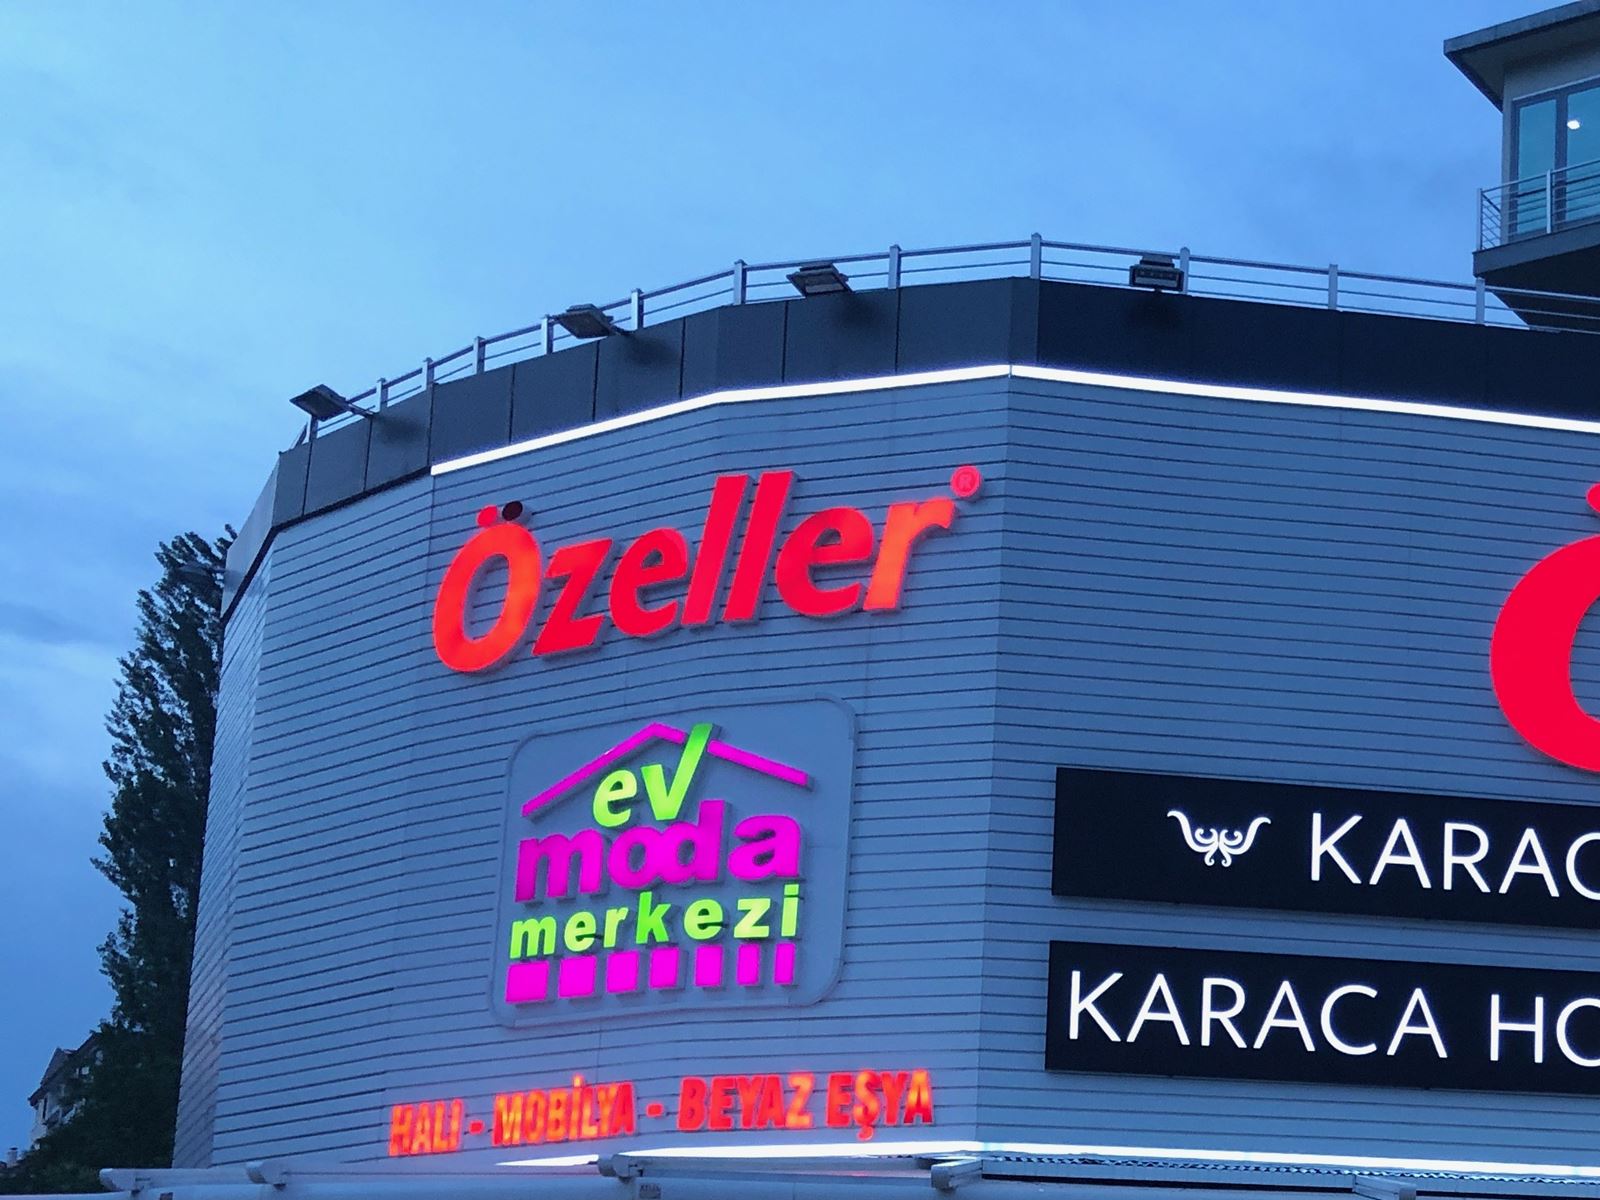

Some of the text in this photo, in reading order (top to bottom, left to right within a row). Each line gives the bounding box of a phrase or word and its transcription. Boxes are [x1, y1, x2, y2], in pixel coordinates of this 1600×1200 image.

[432, 468, 958, 673] Özeller
[592, 722, 714, 828] ev
[515, 799, 801, 902] moda
[509, 883, 800, 960] merkezi
[1067, 969, 1449, 1060] KARACA
[388, 1098, 463, 1157] HALI
[492, 1072, 636, 1147] MOBİLYA
[676, 1072, 815, 1132] BEYAZ
[825, 1069, 935, 1141] EŞYA
